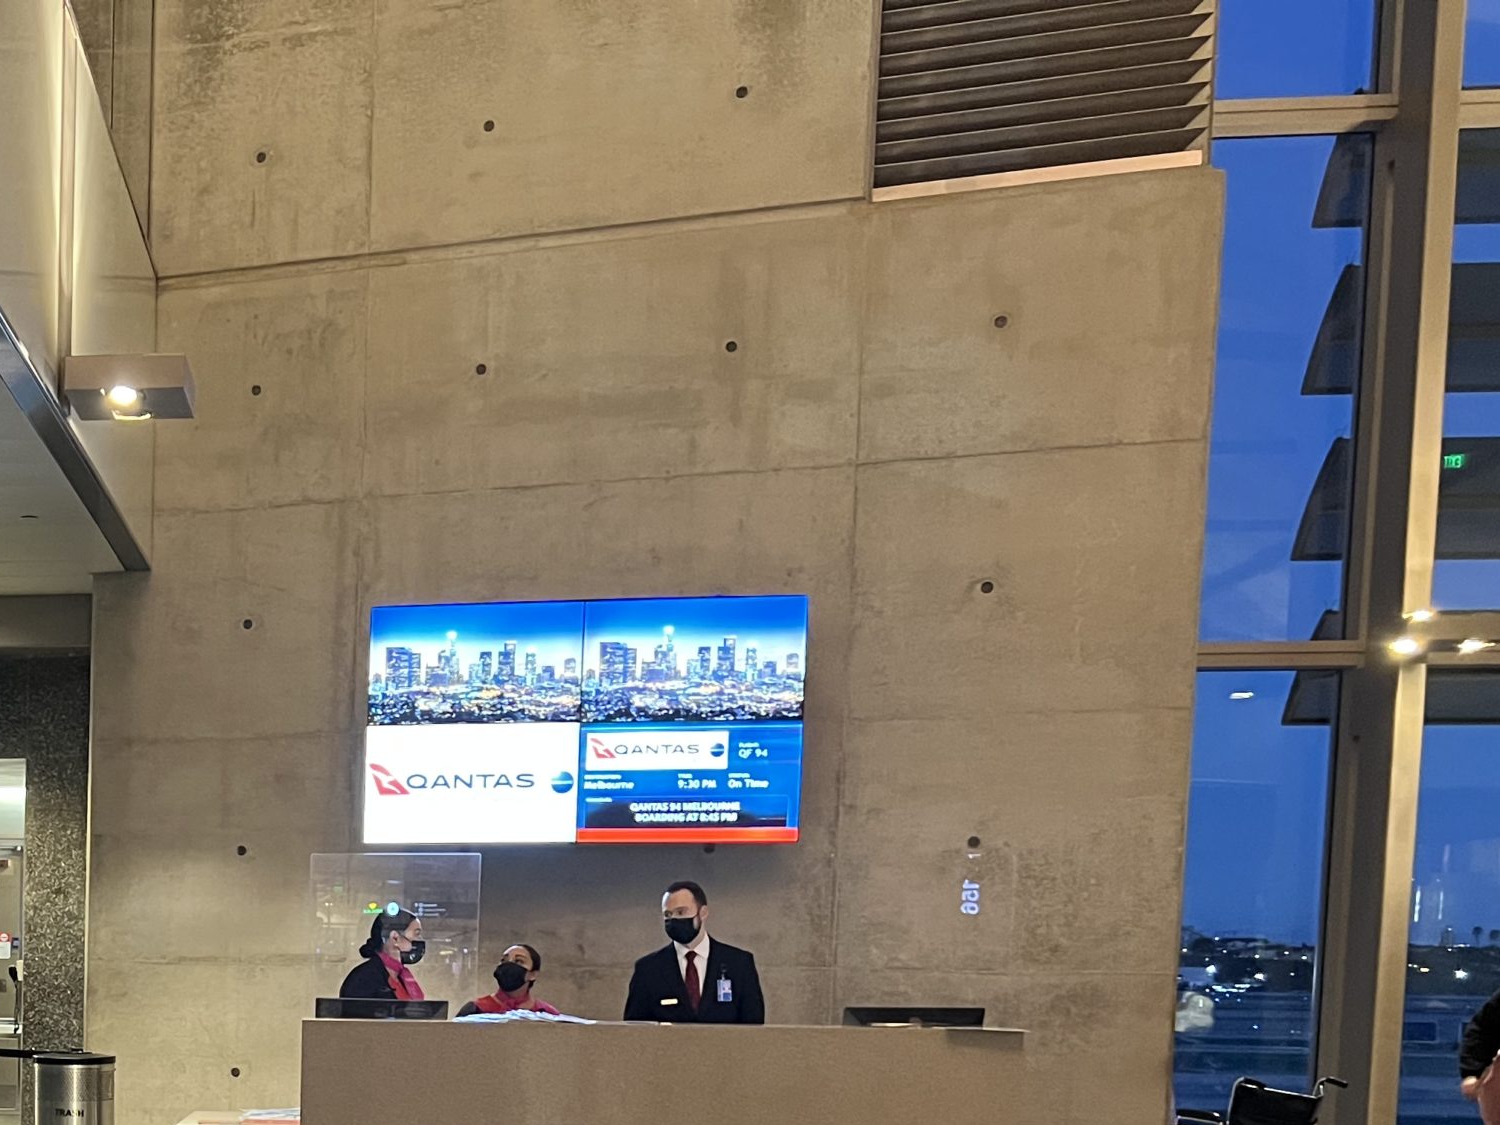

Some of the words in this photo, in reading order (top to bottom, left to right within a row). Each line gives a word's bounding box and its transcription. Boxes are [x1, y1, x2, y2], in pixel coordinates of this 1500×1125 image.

[613, 743, 700, 755] QANTAS
[738, 748, 753, 759] QF
[754, 748, 768, 758] 94
[406, 772, 536, 790] QANTAS
[583, 780, 635, 790] Melbourne
[677, 779, 700, 789] 9:30
[701, 779, 717, 788] PM
[727, 779, 743, 789] On
[744, 779, 769, 789] Time
